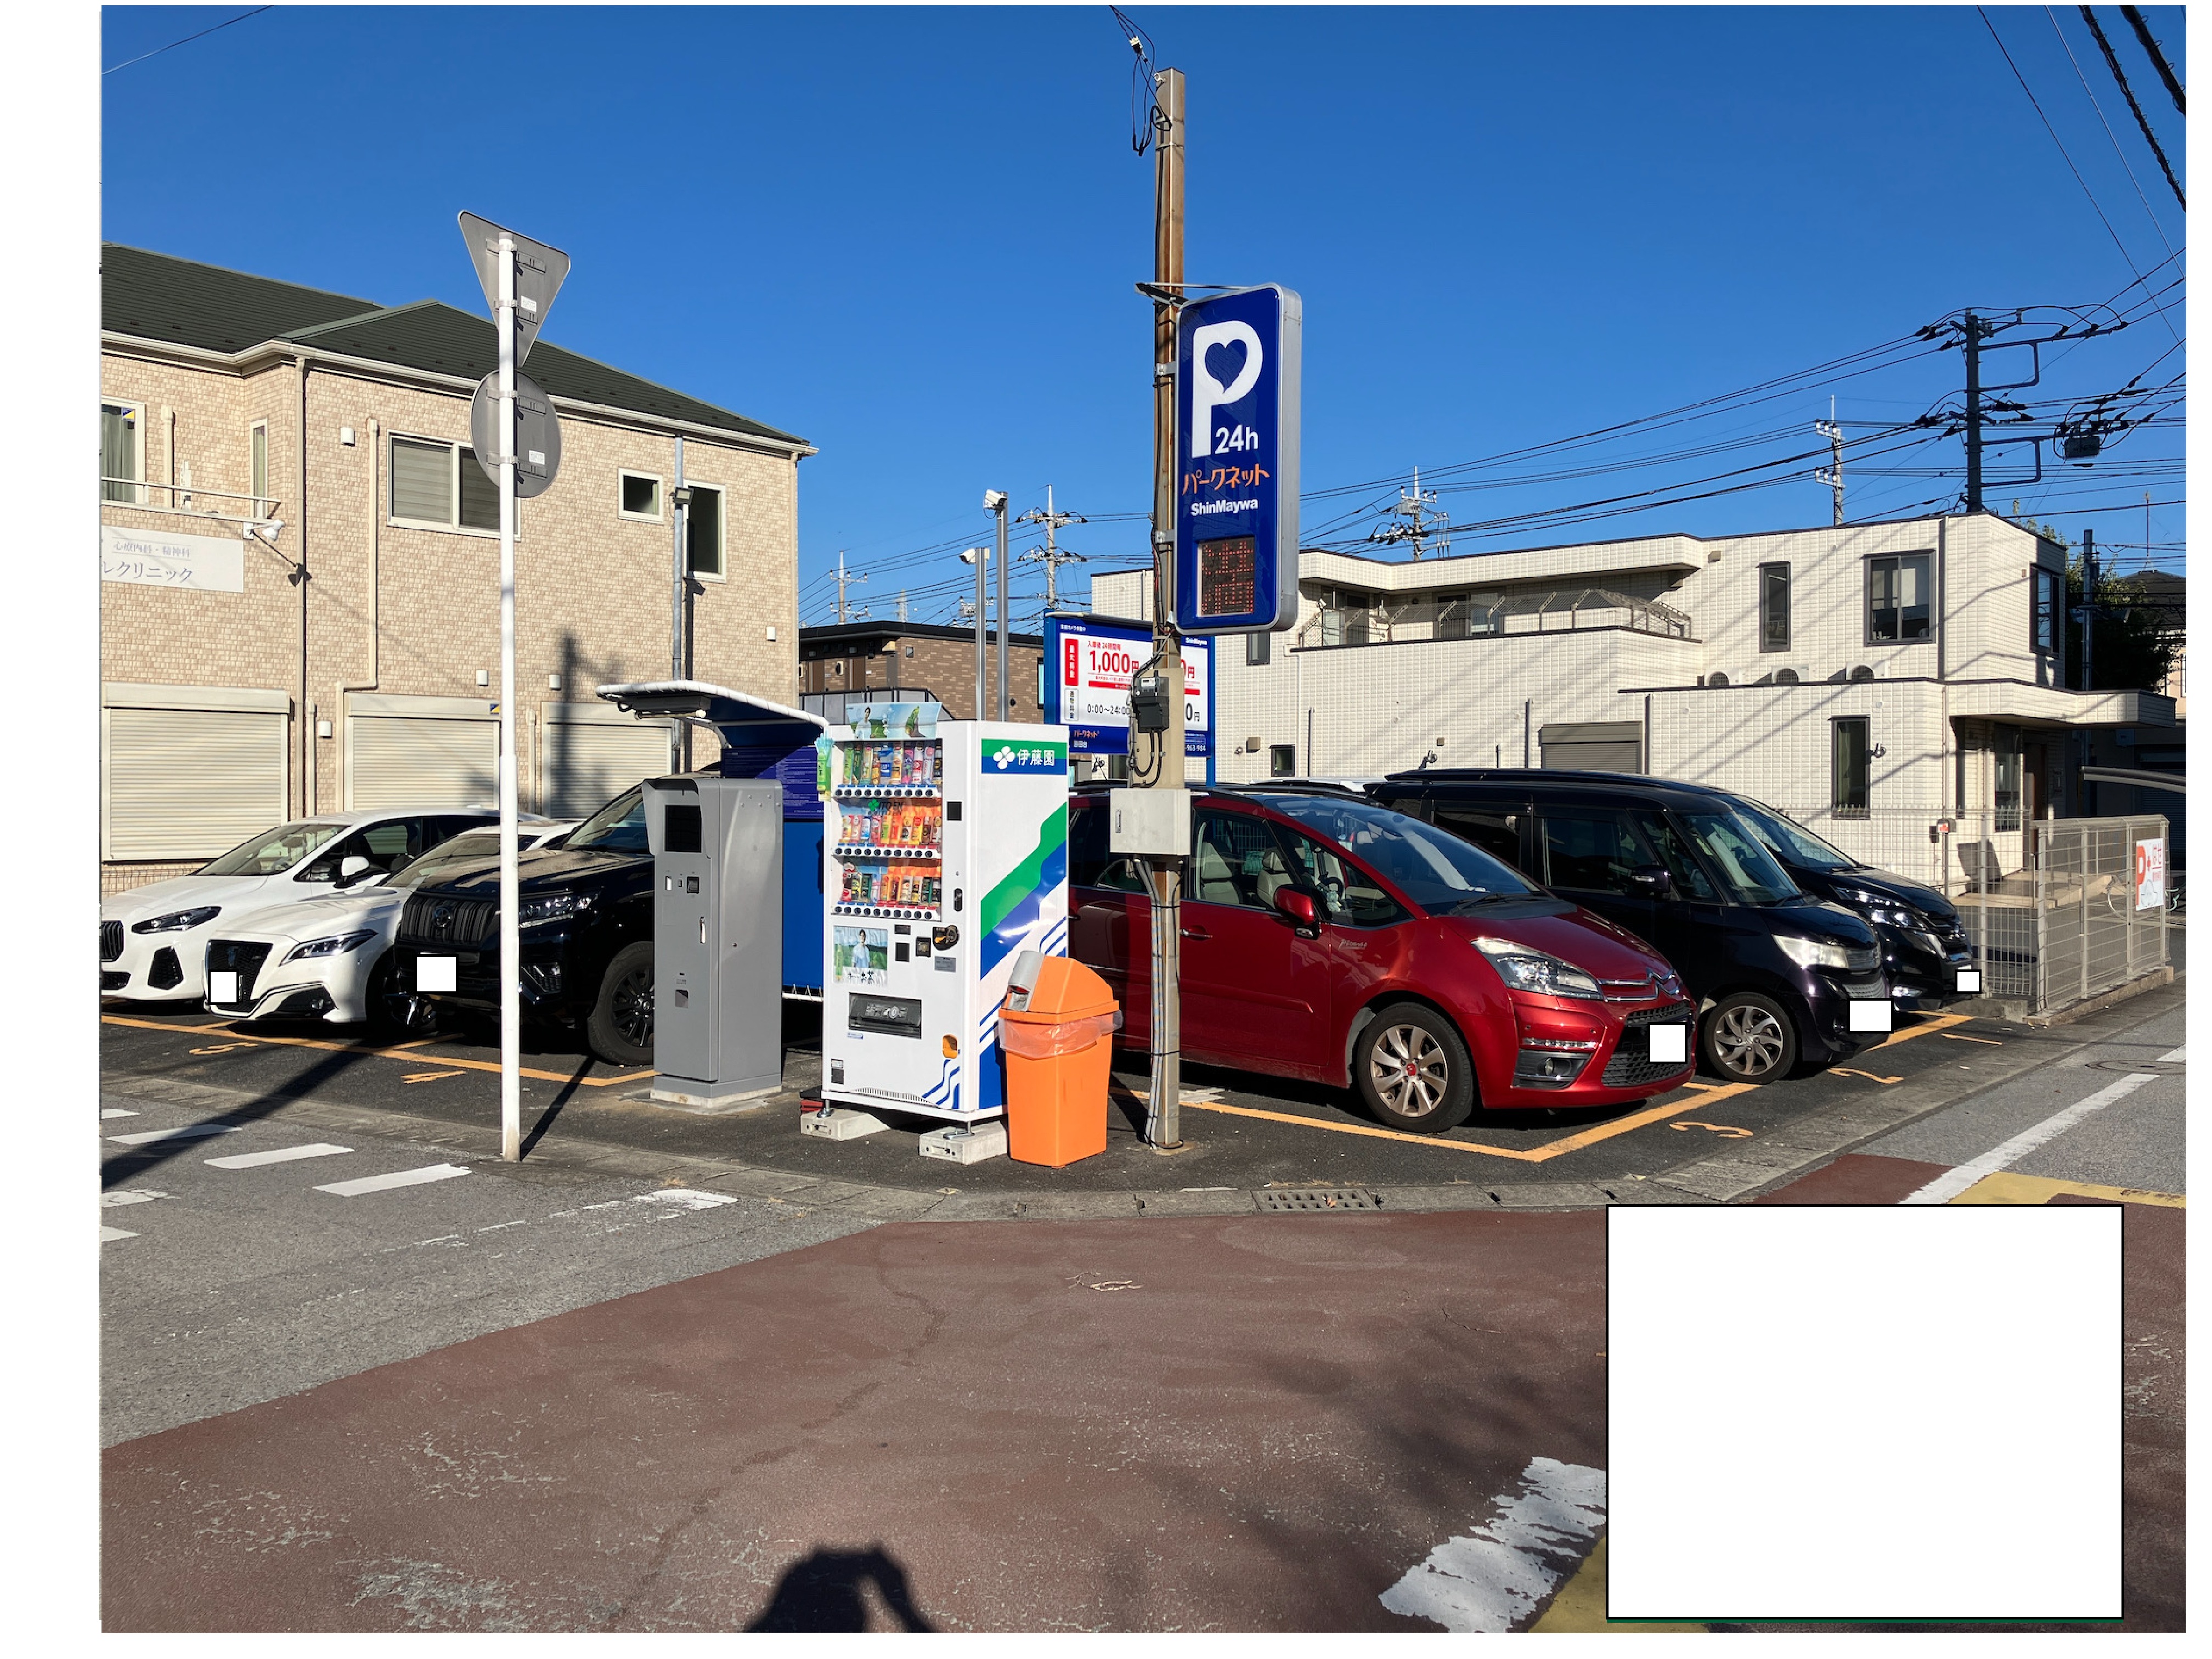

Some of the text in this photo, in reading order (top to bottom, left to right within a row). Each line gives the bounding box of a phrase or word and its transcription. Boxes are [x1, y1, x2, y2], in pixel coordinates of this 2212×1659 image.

[1215, 424, 1259, 455] 24h
[1182, 464, 1270, 495] パークネット
[1190, 499, 1259, 516] ShinMaywa
[1090, 650, 1139, 674] 1,000円
[1017, 749, 1055, 765] 伊藤園
[1827, 1068, 1904, 1084] 2
[1668, 1121, 1753, 1138] 3
